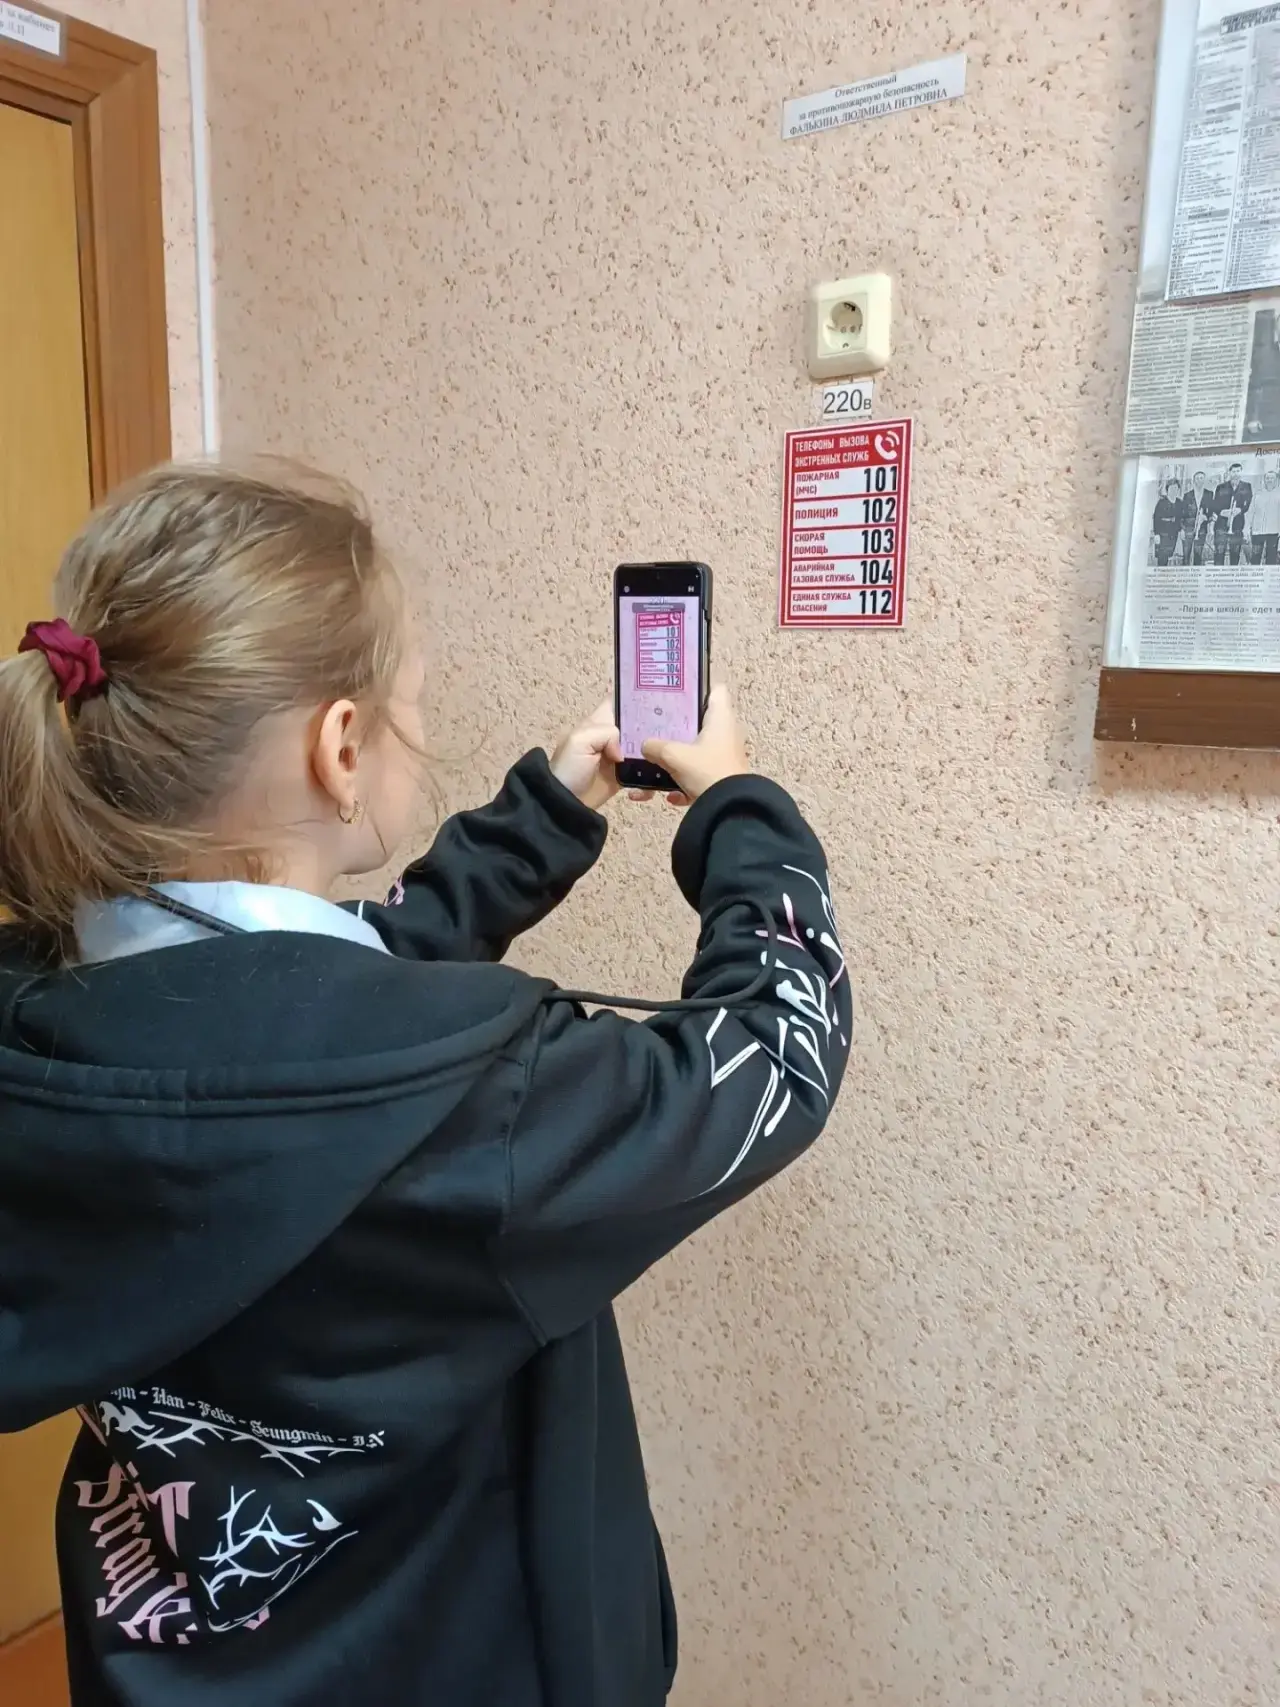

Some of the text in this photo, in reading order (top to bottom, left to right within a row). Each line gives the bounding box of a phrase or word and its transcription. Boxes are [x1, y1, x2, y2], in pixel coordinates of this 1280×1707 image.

[883, 78, 939, 100] безопасность
[841, 103, 892, 123] ЛЮДМИЛА
[894, 88, 948, 109] ПЕТРОВНА
[795, 434, 870, 452] ТЕЛЕФОНЫ ВЫЗОВА
[795, 450, 870, 468] ЭКСТРЕННЫХ СЛУЖБ
[796, 471, 840, 482] ПОЖАРНАЯ
[863, 465, 898, 493] 101
[796, 485, 817, 496] (МЧС)
[795, 497, 896, 524] ПОЛИЦИЯ 102
[794, 533, 825, 542] СКОРАЯ
[861, 528, 894, 555] 103
[794, 545, 829, 555] ПОМОЩЬ
[793, 562, 835, 572] АВАРИЙНАЯ
[860, 559, 893, 585] 104
[793, 574, 855, 583] ГАЗОВАЯ СЛУЖБА
[792, 593, 852, 601] ЕДИНАЯ СЛУЖБА
[859, 590, 892, 615] 112
[792, 604, 828, 612] СПАСЕНИЯ
[151, 1387, 185, 1409] Han
[197, 1400, 237, 1425] Felix
[250, 1420, 334, 1443] Seungmin
